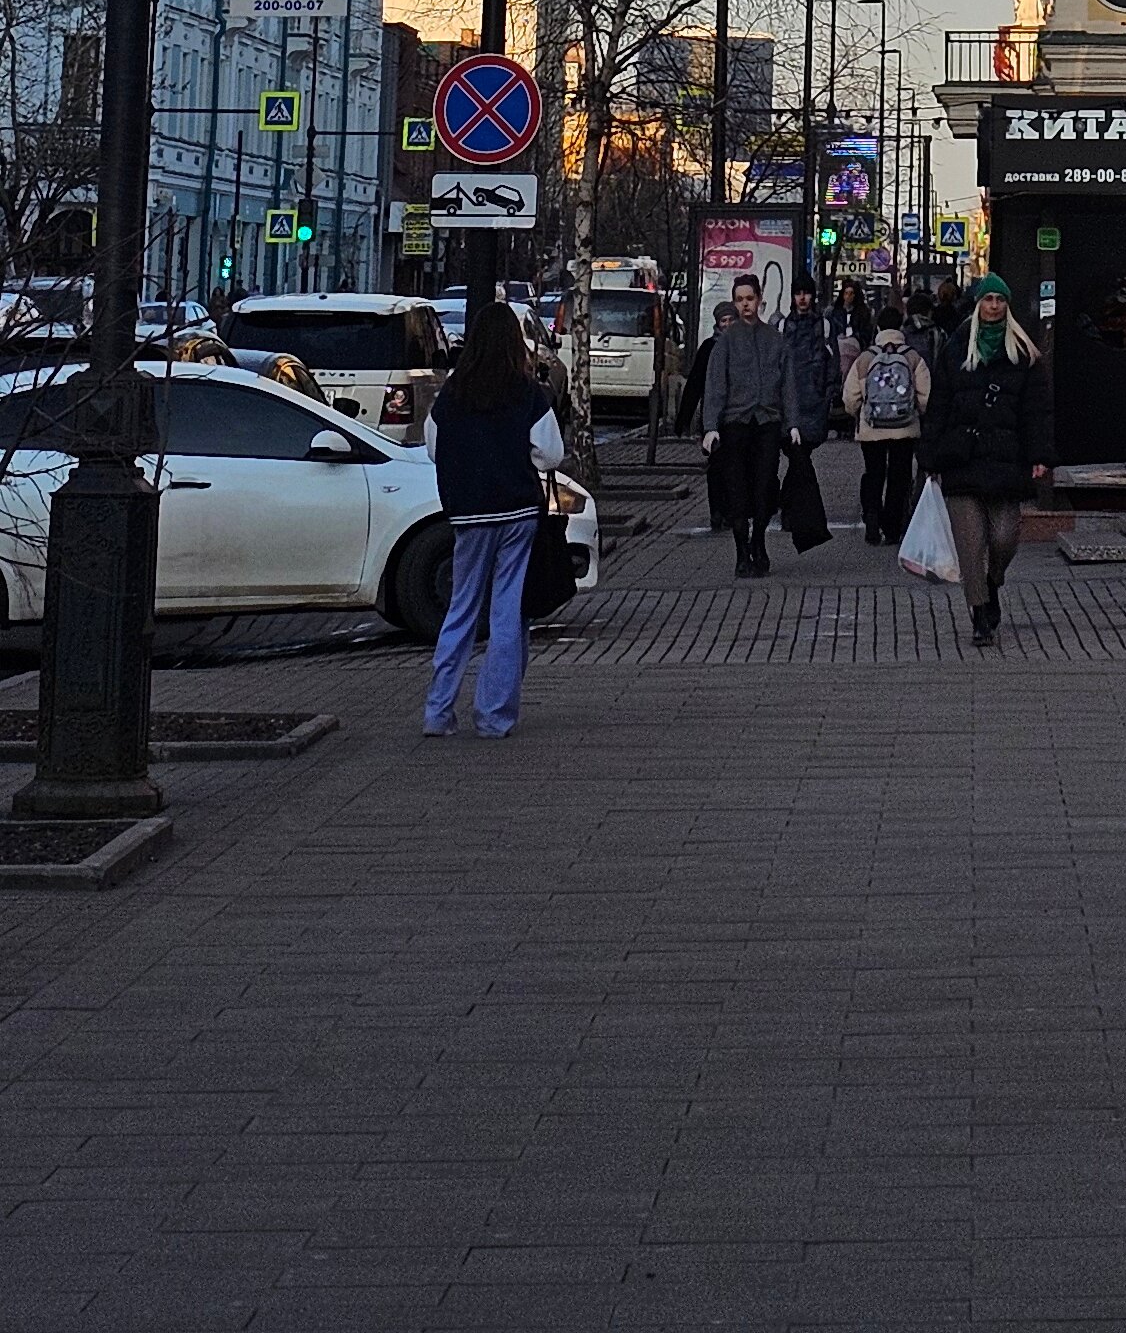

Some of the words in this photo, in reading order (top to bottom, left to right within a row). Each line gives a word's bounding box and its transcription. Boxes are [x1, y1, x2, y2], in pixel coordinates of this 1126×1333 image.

[254, 0, 324, 11] 200-00-07
[1004, 171, 1060, 183] доставка
[704, 218, 750, 230] OZON
[708, 255, 717, 267] 5
[836, 261, 867, 274] ТОП
